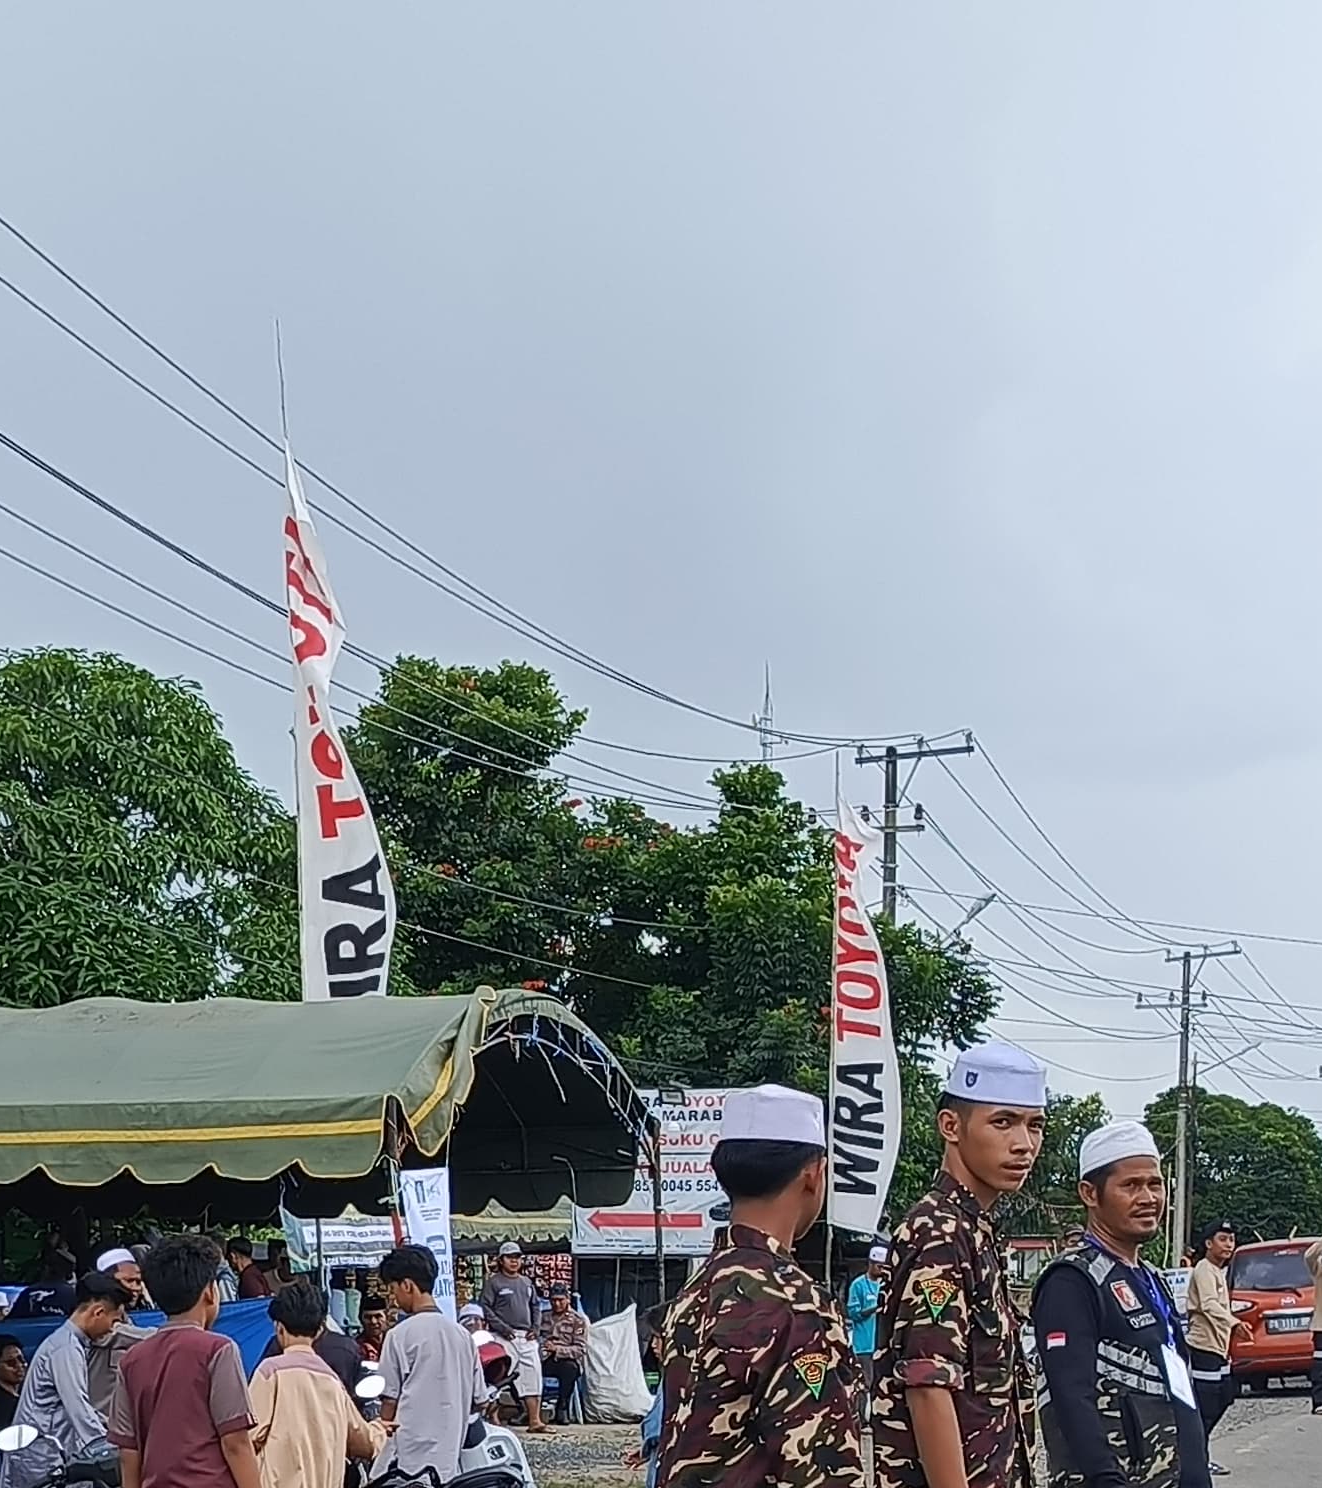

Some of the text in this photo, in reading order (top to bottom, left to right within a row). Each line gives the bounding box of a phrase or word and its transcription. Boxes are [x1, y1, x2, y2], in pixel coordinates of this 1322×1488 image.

[321, 852, 387, 998] IRA
[662, 1109, 723, 1122] MARAB
[834, 1062, 885, 1195] WIRA
[661, 1179, 692, 1192] 0045
[695, 1179, 719, 1192] 554
